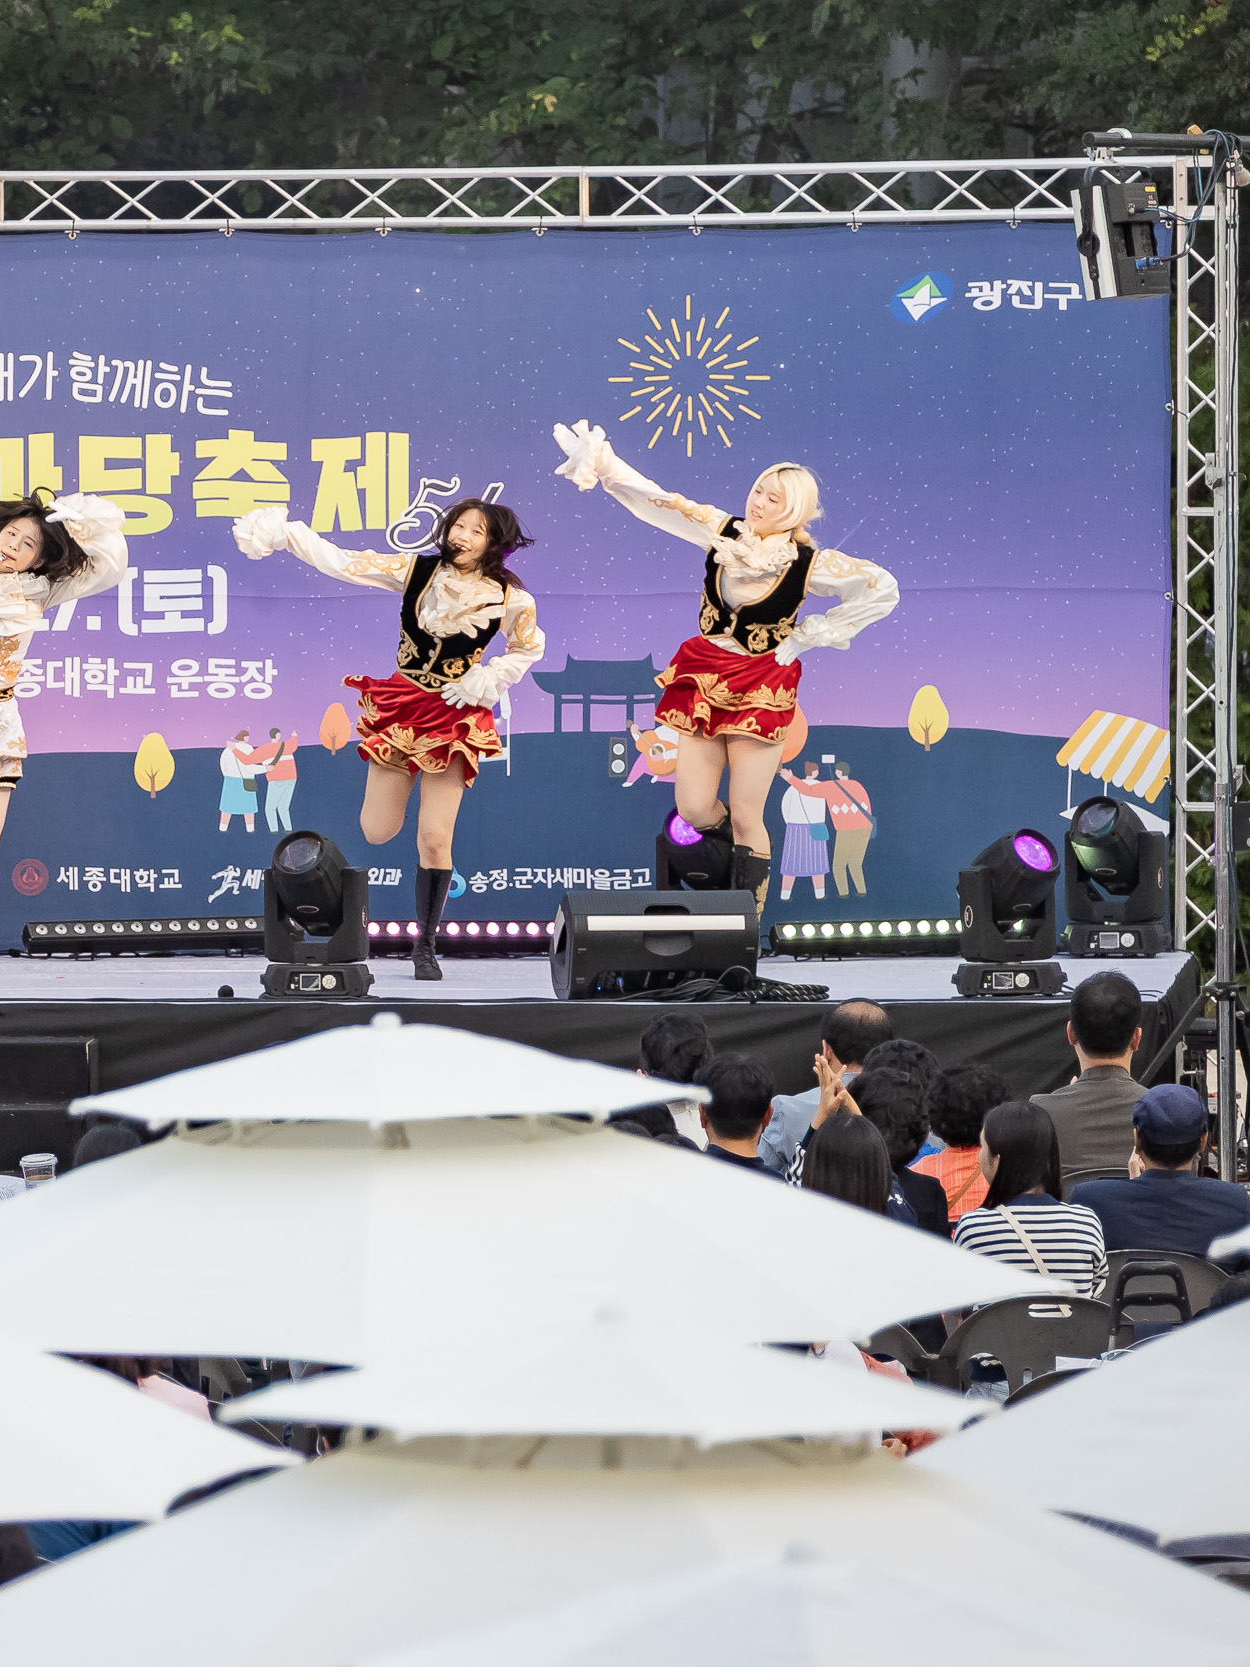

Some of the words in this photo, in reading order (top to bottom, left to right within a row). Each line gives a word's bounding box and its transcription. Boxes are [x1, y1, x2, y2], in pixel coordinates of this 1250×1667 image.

[964, 278, 1084, 311] 광진구
[68, 350, 233, 416] 함께하는
[12, 656, 156, 700] 종대학교
[166, 657, 278, 700] 운동장
[56, 866, 183, 893] 세종대학교
[468, 867, 652, 894] 송정.군자새마을금고
